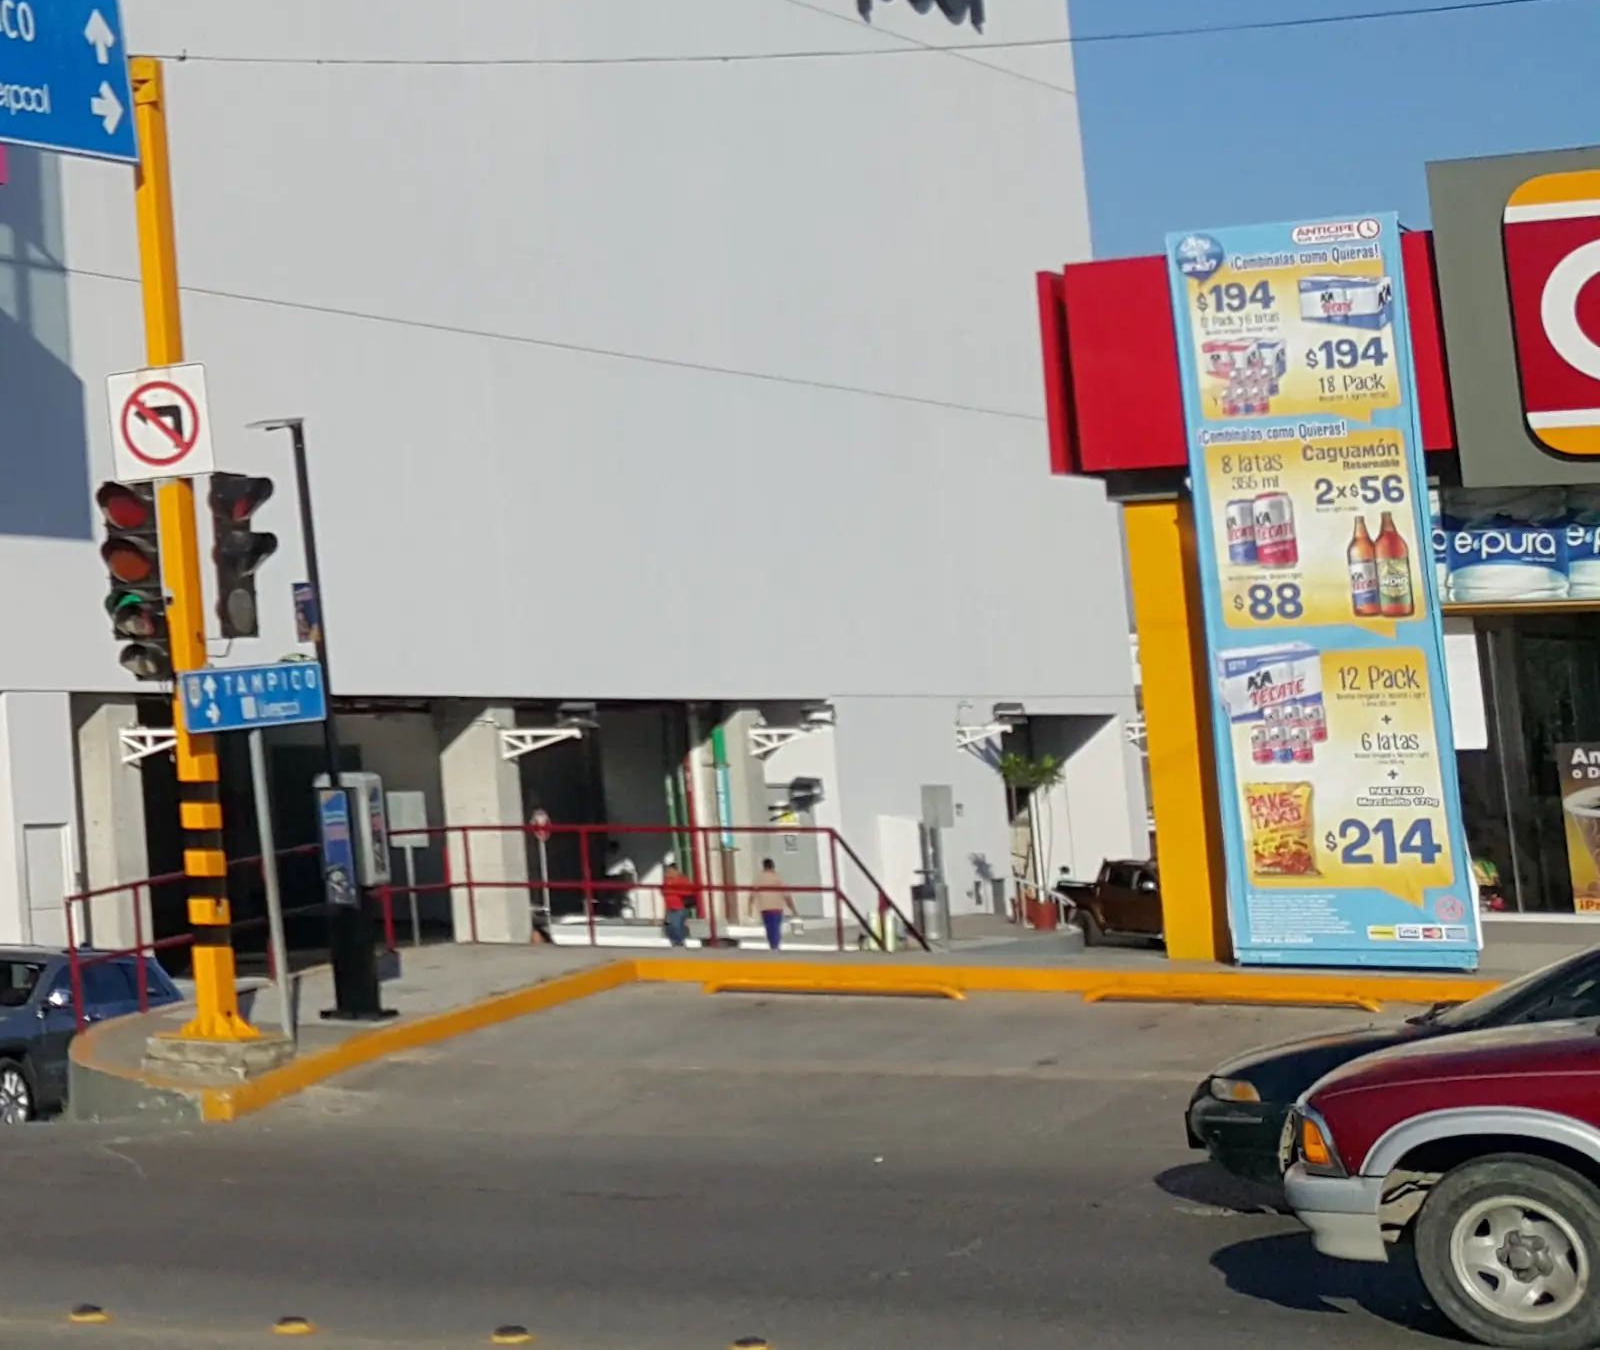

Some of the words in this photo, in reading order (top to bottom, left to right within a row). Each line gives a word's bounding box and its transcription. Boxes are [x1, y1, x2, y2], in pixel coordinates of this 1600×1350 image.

[1295, 223, 1355, 237] ANTICIPE
[1299, 250, 1328, 265] como
[1331, 243, 1379, 265] Quieras!
[1319, 376, 1336, 394] 18
[1342, 373, 1386, 392] Pack
[1266, 426, 1295, 440] como
[1298, 420, 1347, 440] Quieras!
[1301, 438, 1401, 463] Caguamón
[1221, 456, 1233, 474] 8
[1237, 453, 1284, 473] latas
[222, 668, 318, 697] TAMPICO
[1338, 666, 1360, 691] 12
[1367, 664, 1421, 691] Pack
[1248, 678, 1306, 707] TECATE
[1360, 731, 1372, 751] 6
[1376, 731, 1420, 751] latas
[1324, 817, 1443, 865] $214
